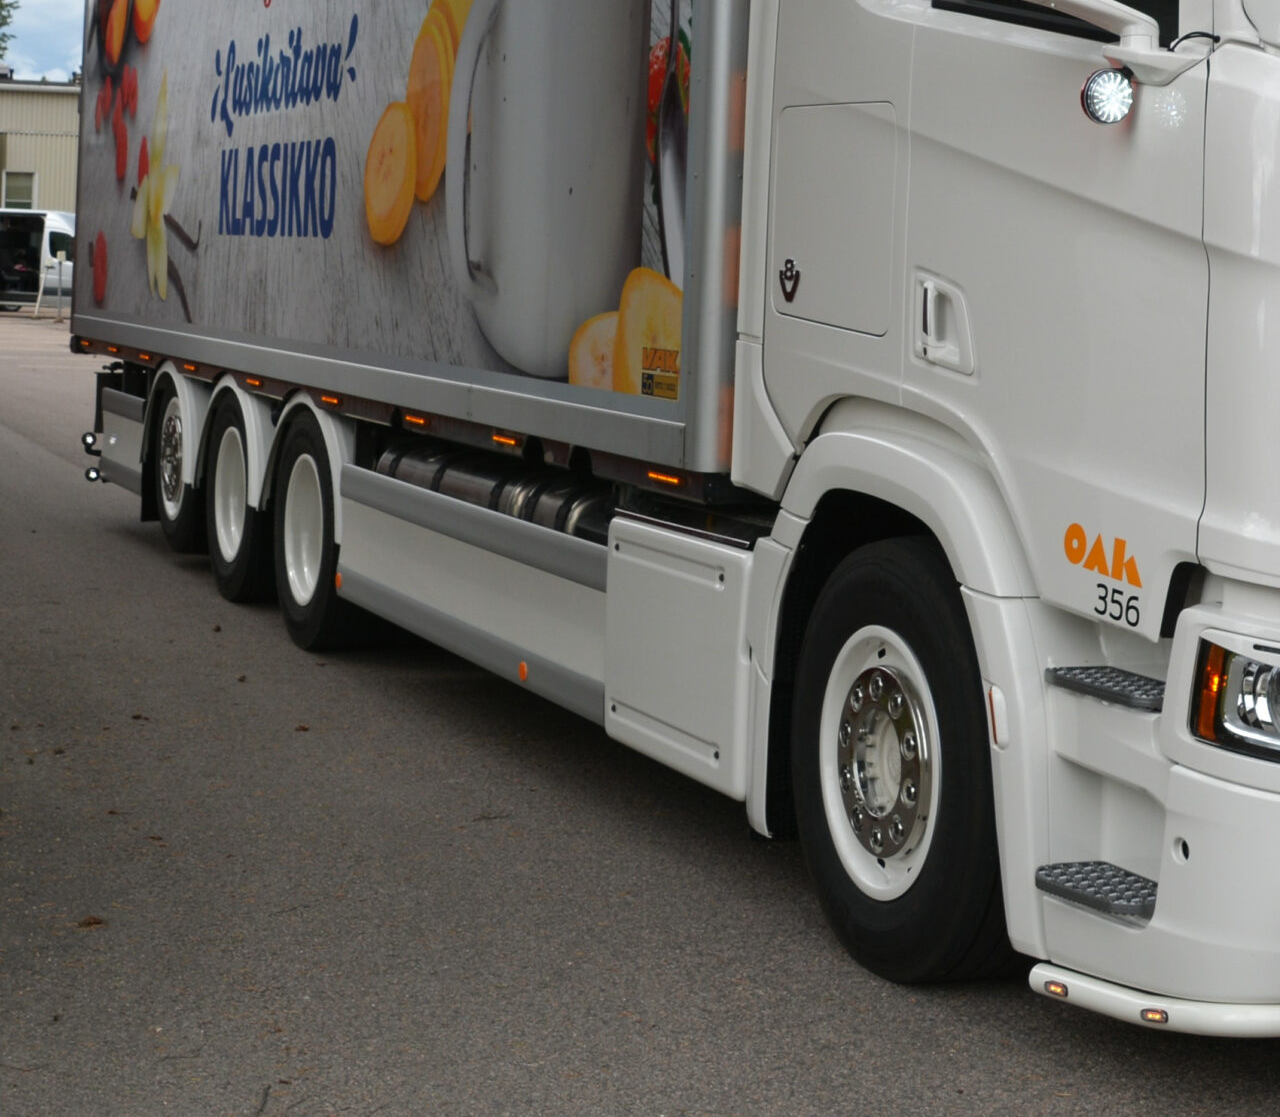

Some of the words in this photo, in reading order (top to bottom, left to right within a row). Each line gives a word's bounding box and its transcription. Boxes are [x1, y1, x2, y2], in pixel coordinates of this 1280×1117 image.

[218, 137, 336, 239] KLASSIKKO
[642, 346, 680, 374] VAK
[1094, 583, 1140, 627] 356
